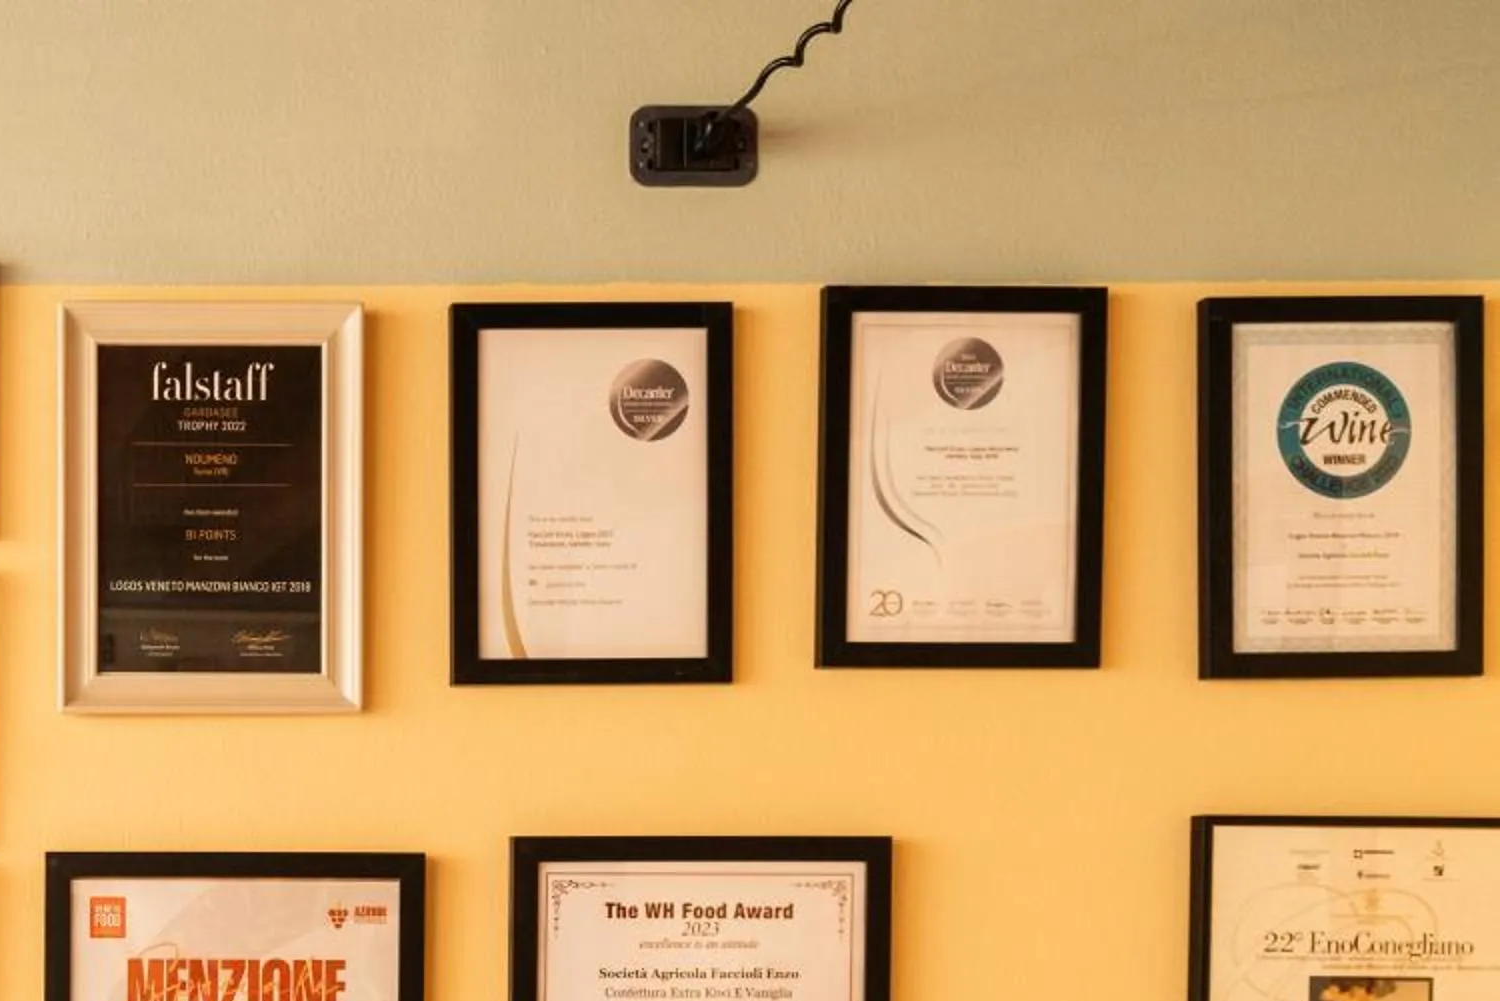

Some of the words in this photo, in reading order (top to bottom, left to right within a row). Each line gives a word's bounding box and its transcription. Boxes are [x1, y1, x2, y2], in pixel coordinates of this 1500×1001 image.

[153, 361, 275, 401] falstaff
[1311, 389, 1377, 414] COMMENDED
[178, 421, 219, 431] TROPHY
[222, 421, 247, 431] 2022
[1281, 411, 1408, 446] Wine
[1323, 455, 1366, 465] WINNER
[199, 530, 236, 540] POINTS
[110, 581, 143, 591] LOGOS
[144, 581, 184, 592] VENETO
[186, 581, 230, 592] MANZONI
[232, 582, 269, 592] BIANCO
[272, 582, 287, 592] IGT
[289, 582, 311, 592] 2018
[605, 903, 638, 919] The
[645, 903, 674, 918] WH
[682, 903, 726, 918] Food
[734, 903, 794, 919] Award
[682, 922, 720, 936] 2023
[1264, 931, 1303, 953] 22°
[1309, 931, 1475, 959] EnoConegliano
[599, 968, 648, 979] Società
[651, 968, 707, 981] Agricola
[711, 968, 762, 979] Faccioli
[766, 969, 800, 979] Enzo
[604, 987, 667, 999] Confettura
[671, 987, 701, 999] Extra
[704, 987, 732, 999] Kiwi
[735, 988, 743, 998] E
[745, 987, 793, 1001] Vaniglia
